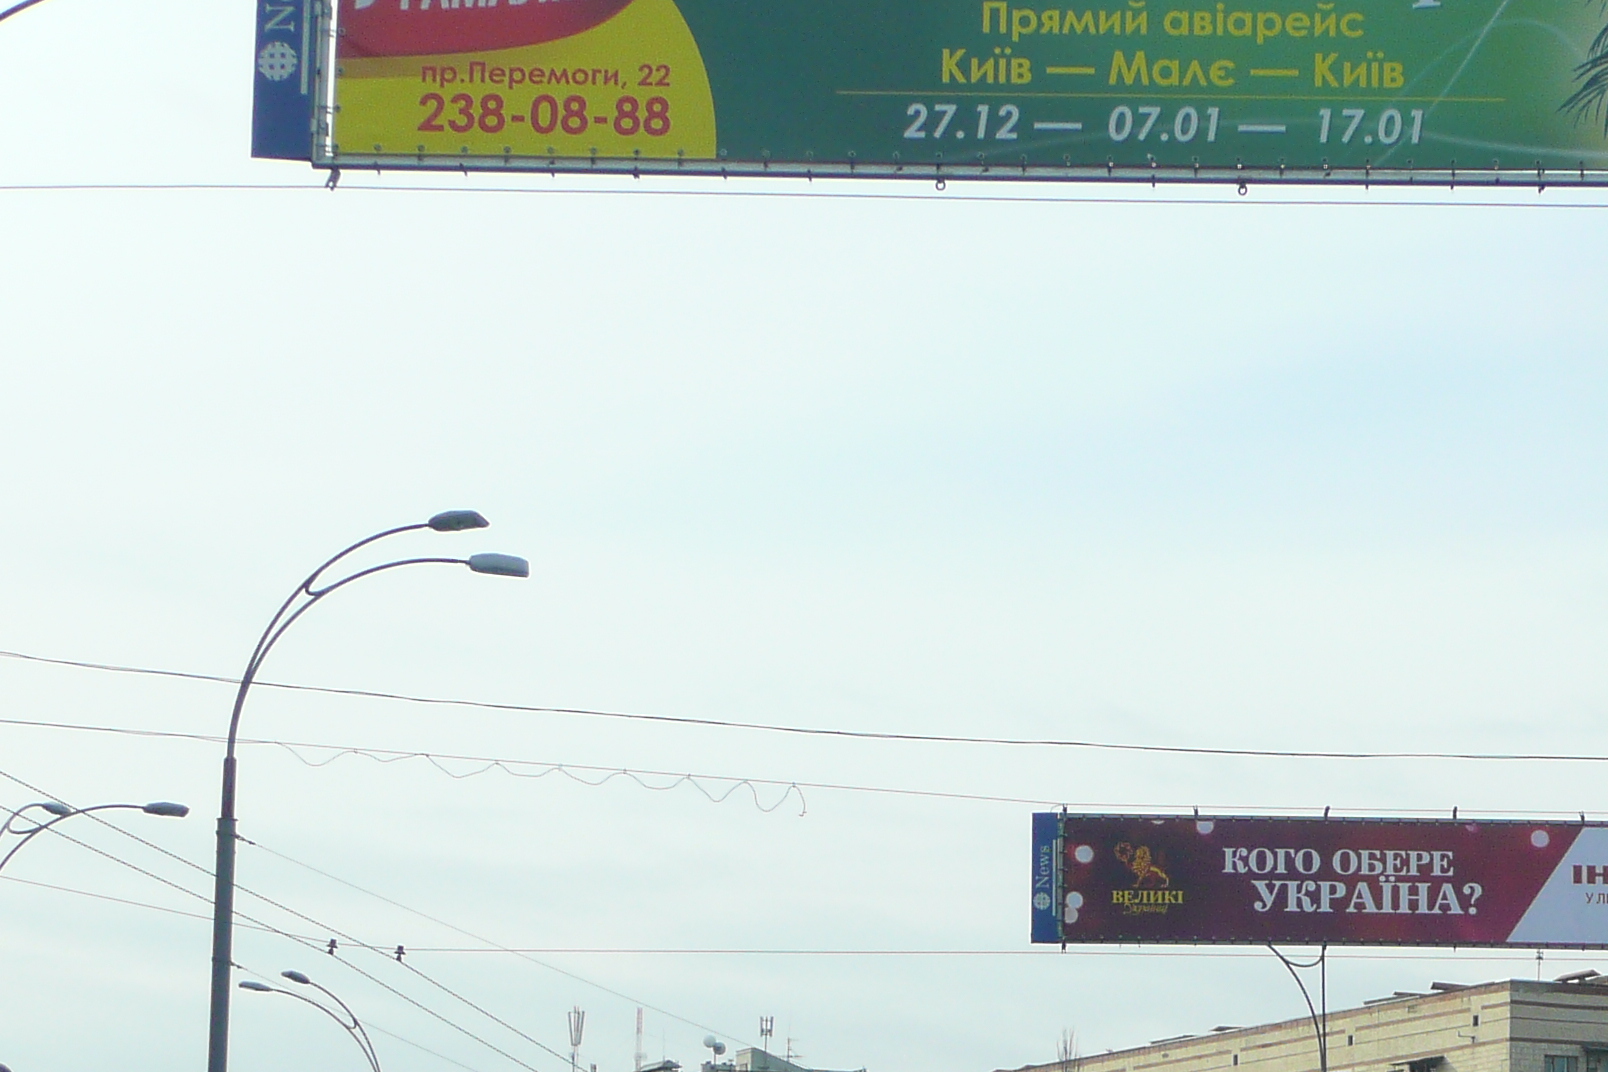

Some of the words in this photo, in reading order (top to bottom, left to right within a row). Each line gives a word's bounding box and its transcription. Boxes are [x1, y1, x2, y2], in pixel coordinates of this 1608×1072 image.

[981, 3, 1149, 40] Прямий
[1163, 2, 1366, 44] авіарейс
[421, 61, 628, 90] пр.Перемоги,
[637, 64, 671, 87] 22
[941, 48, 1033, 85] Київ
[1109, 53, 1235, 89] Малє
[1313, 52, 1405, 90] Київ
[417, 92, 671, 136] 238-08-88
[903, 104, 1019, 141] 27.12
[1108, 106, 1221, 143] 07.01
[1318, 108, 1425, 145] 17.01
[1221, 847, 1321, 875] КОГО
[1332, 848, 1454, 877] ОБЕРЕ
[1111, 890, 1184, 904] ВЕЛИКІ
[1250, 876, 1482, 915] УКРАЇНА?
[1585, 893, 1595, 905] У
